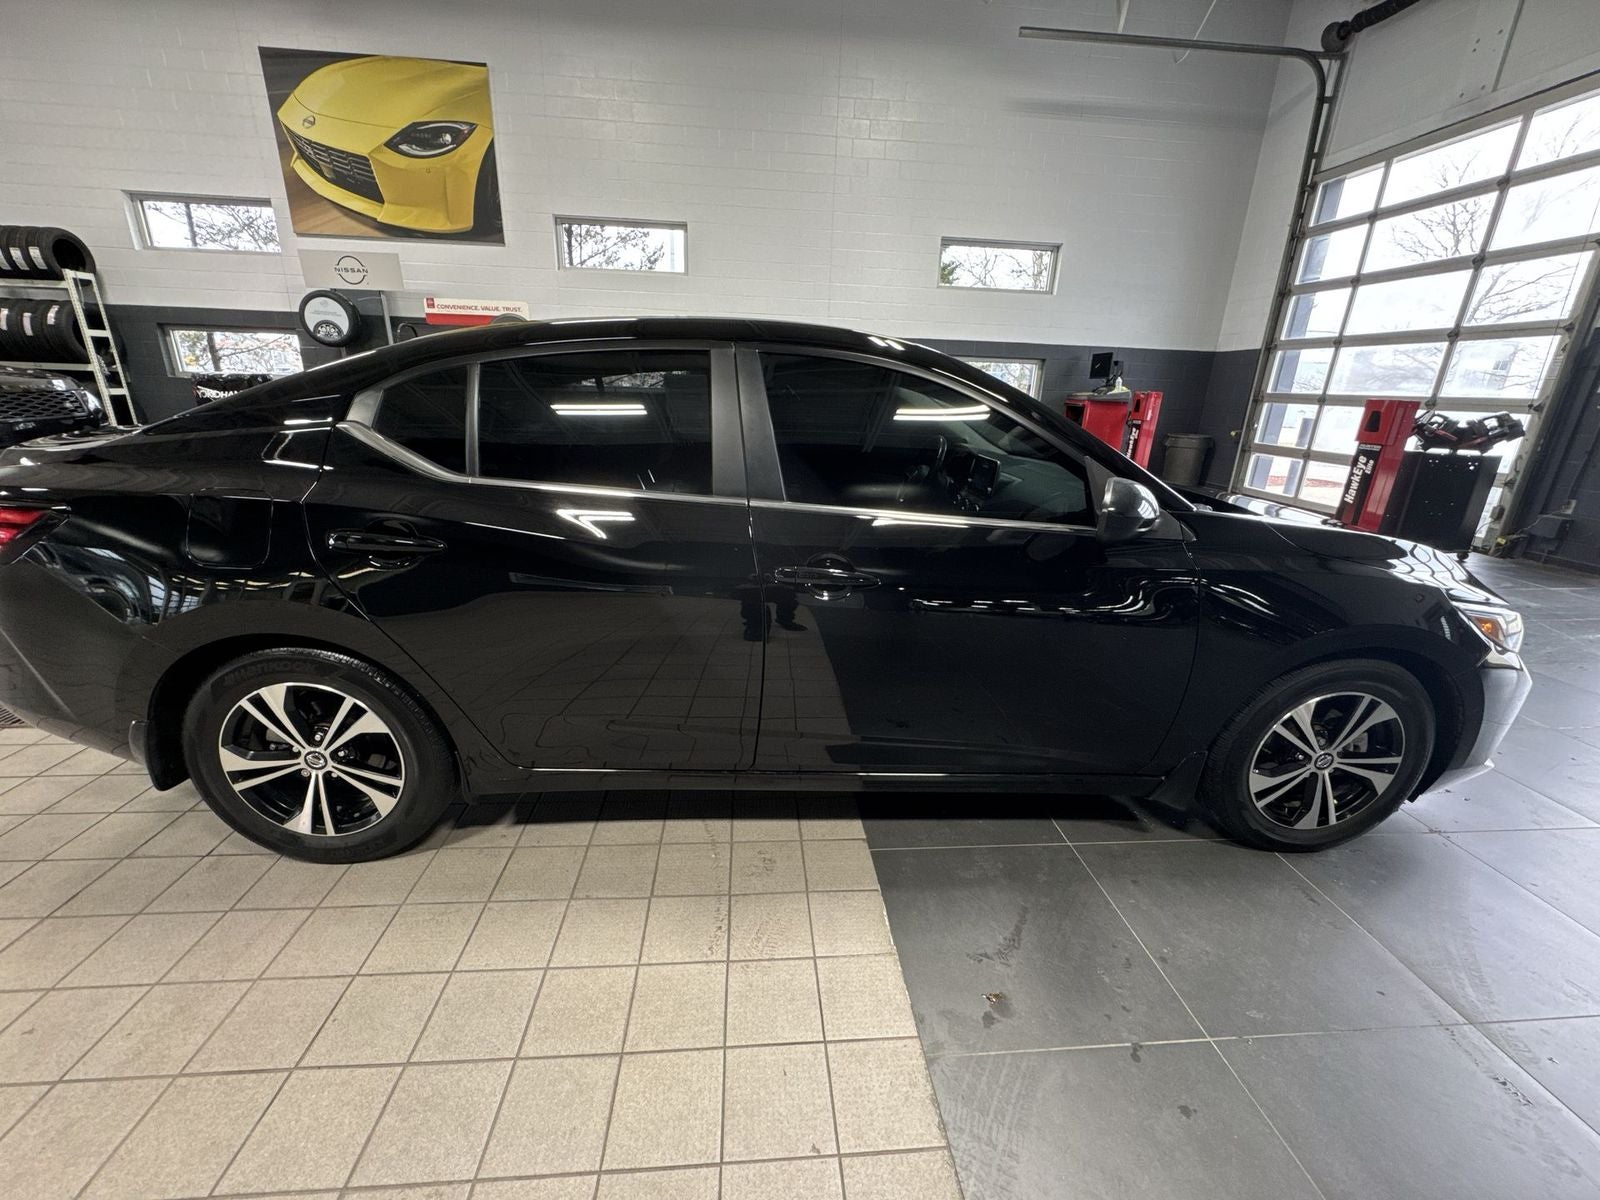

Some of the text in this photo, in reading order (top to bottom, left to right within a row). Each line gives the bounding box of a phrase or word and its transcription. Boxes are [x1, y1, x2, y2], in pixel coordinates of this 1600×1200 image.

[334, 266, 368, 274] NISSAN
[436, 303, 480, 311] CONVENIENCE.
[1344, 456, 1367, 503] HawkEye
